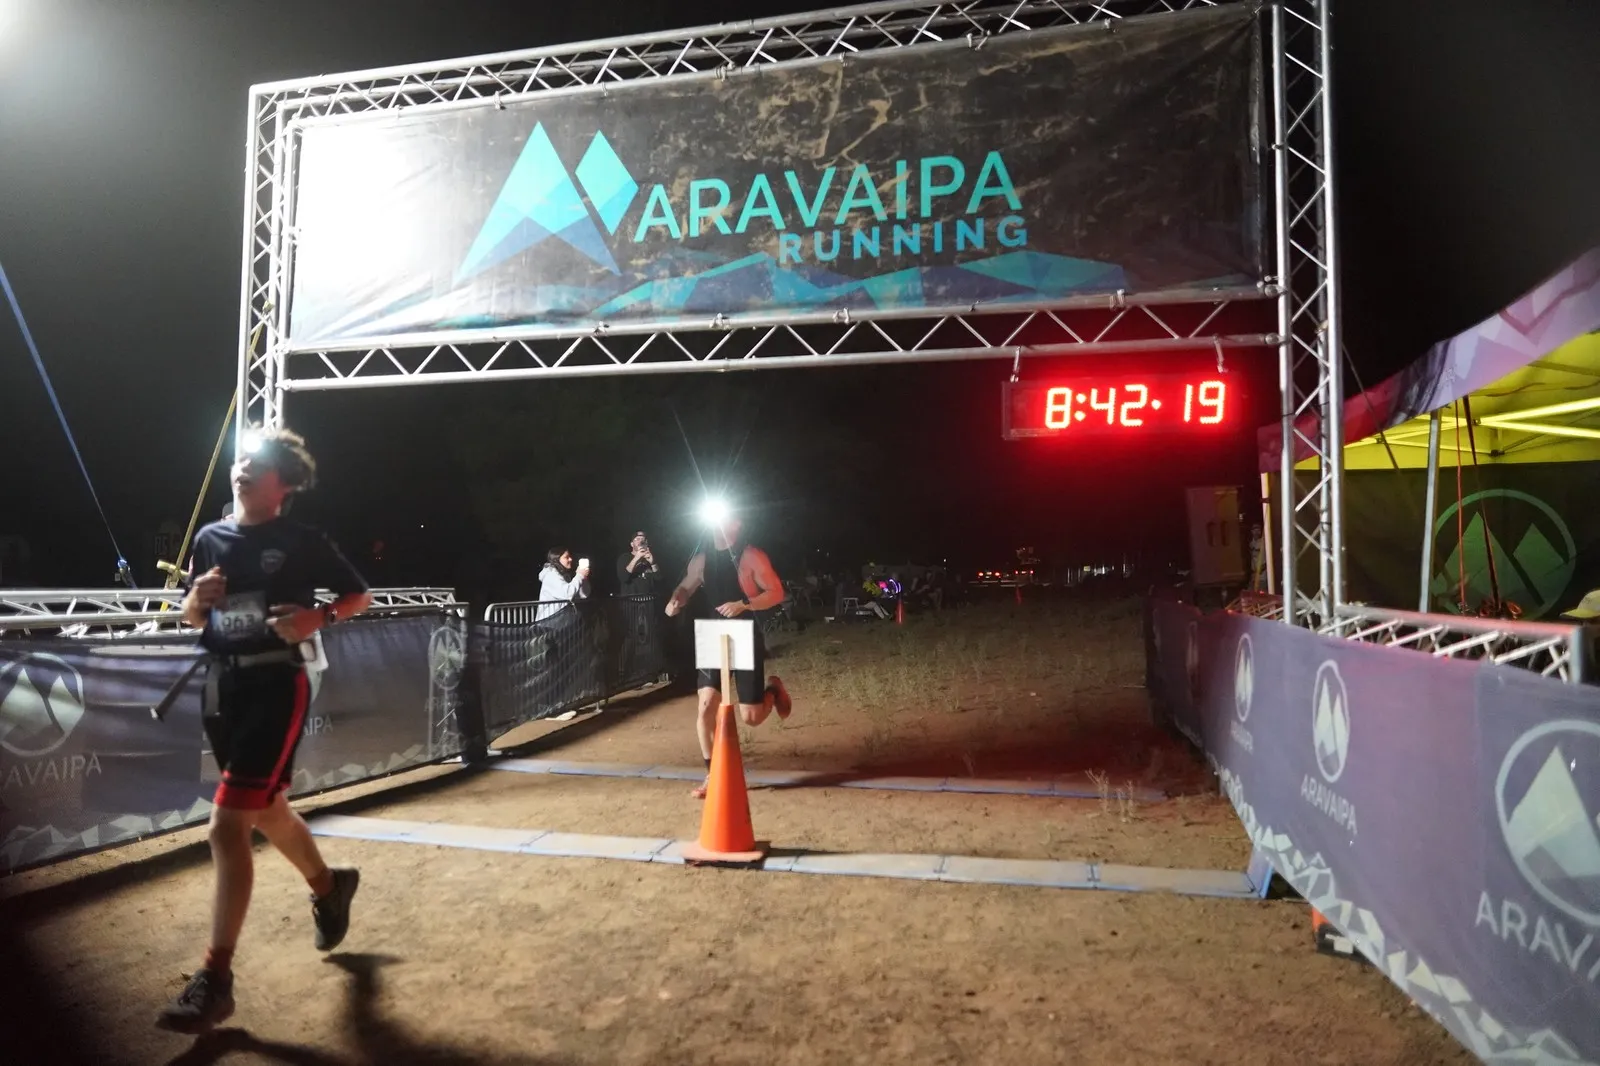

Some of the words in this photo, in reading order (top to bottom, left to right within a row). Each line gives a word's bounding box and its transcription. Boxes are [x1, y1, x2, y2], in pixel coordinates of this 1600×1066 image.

[634, 150, 1022, 243] ARAVAIPA
[779, 215, 1028, 264] RUNNING
[0, 750, 102, 788] AVAIPA
